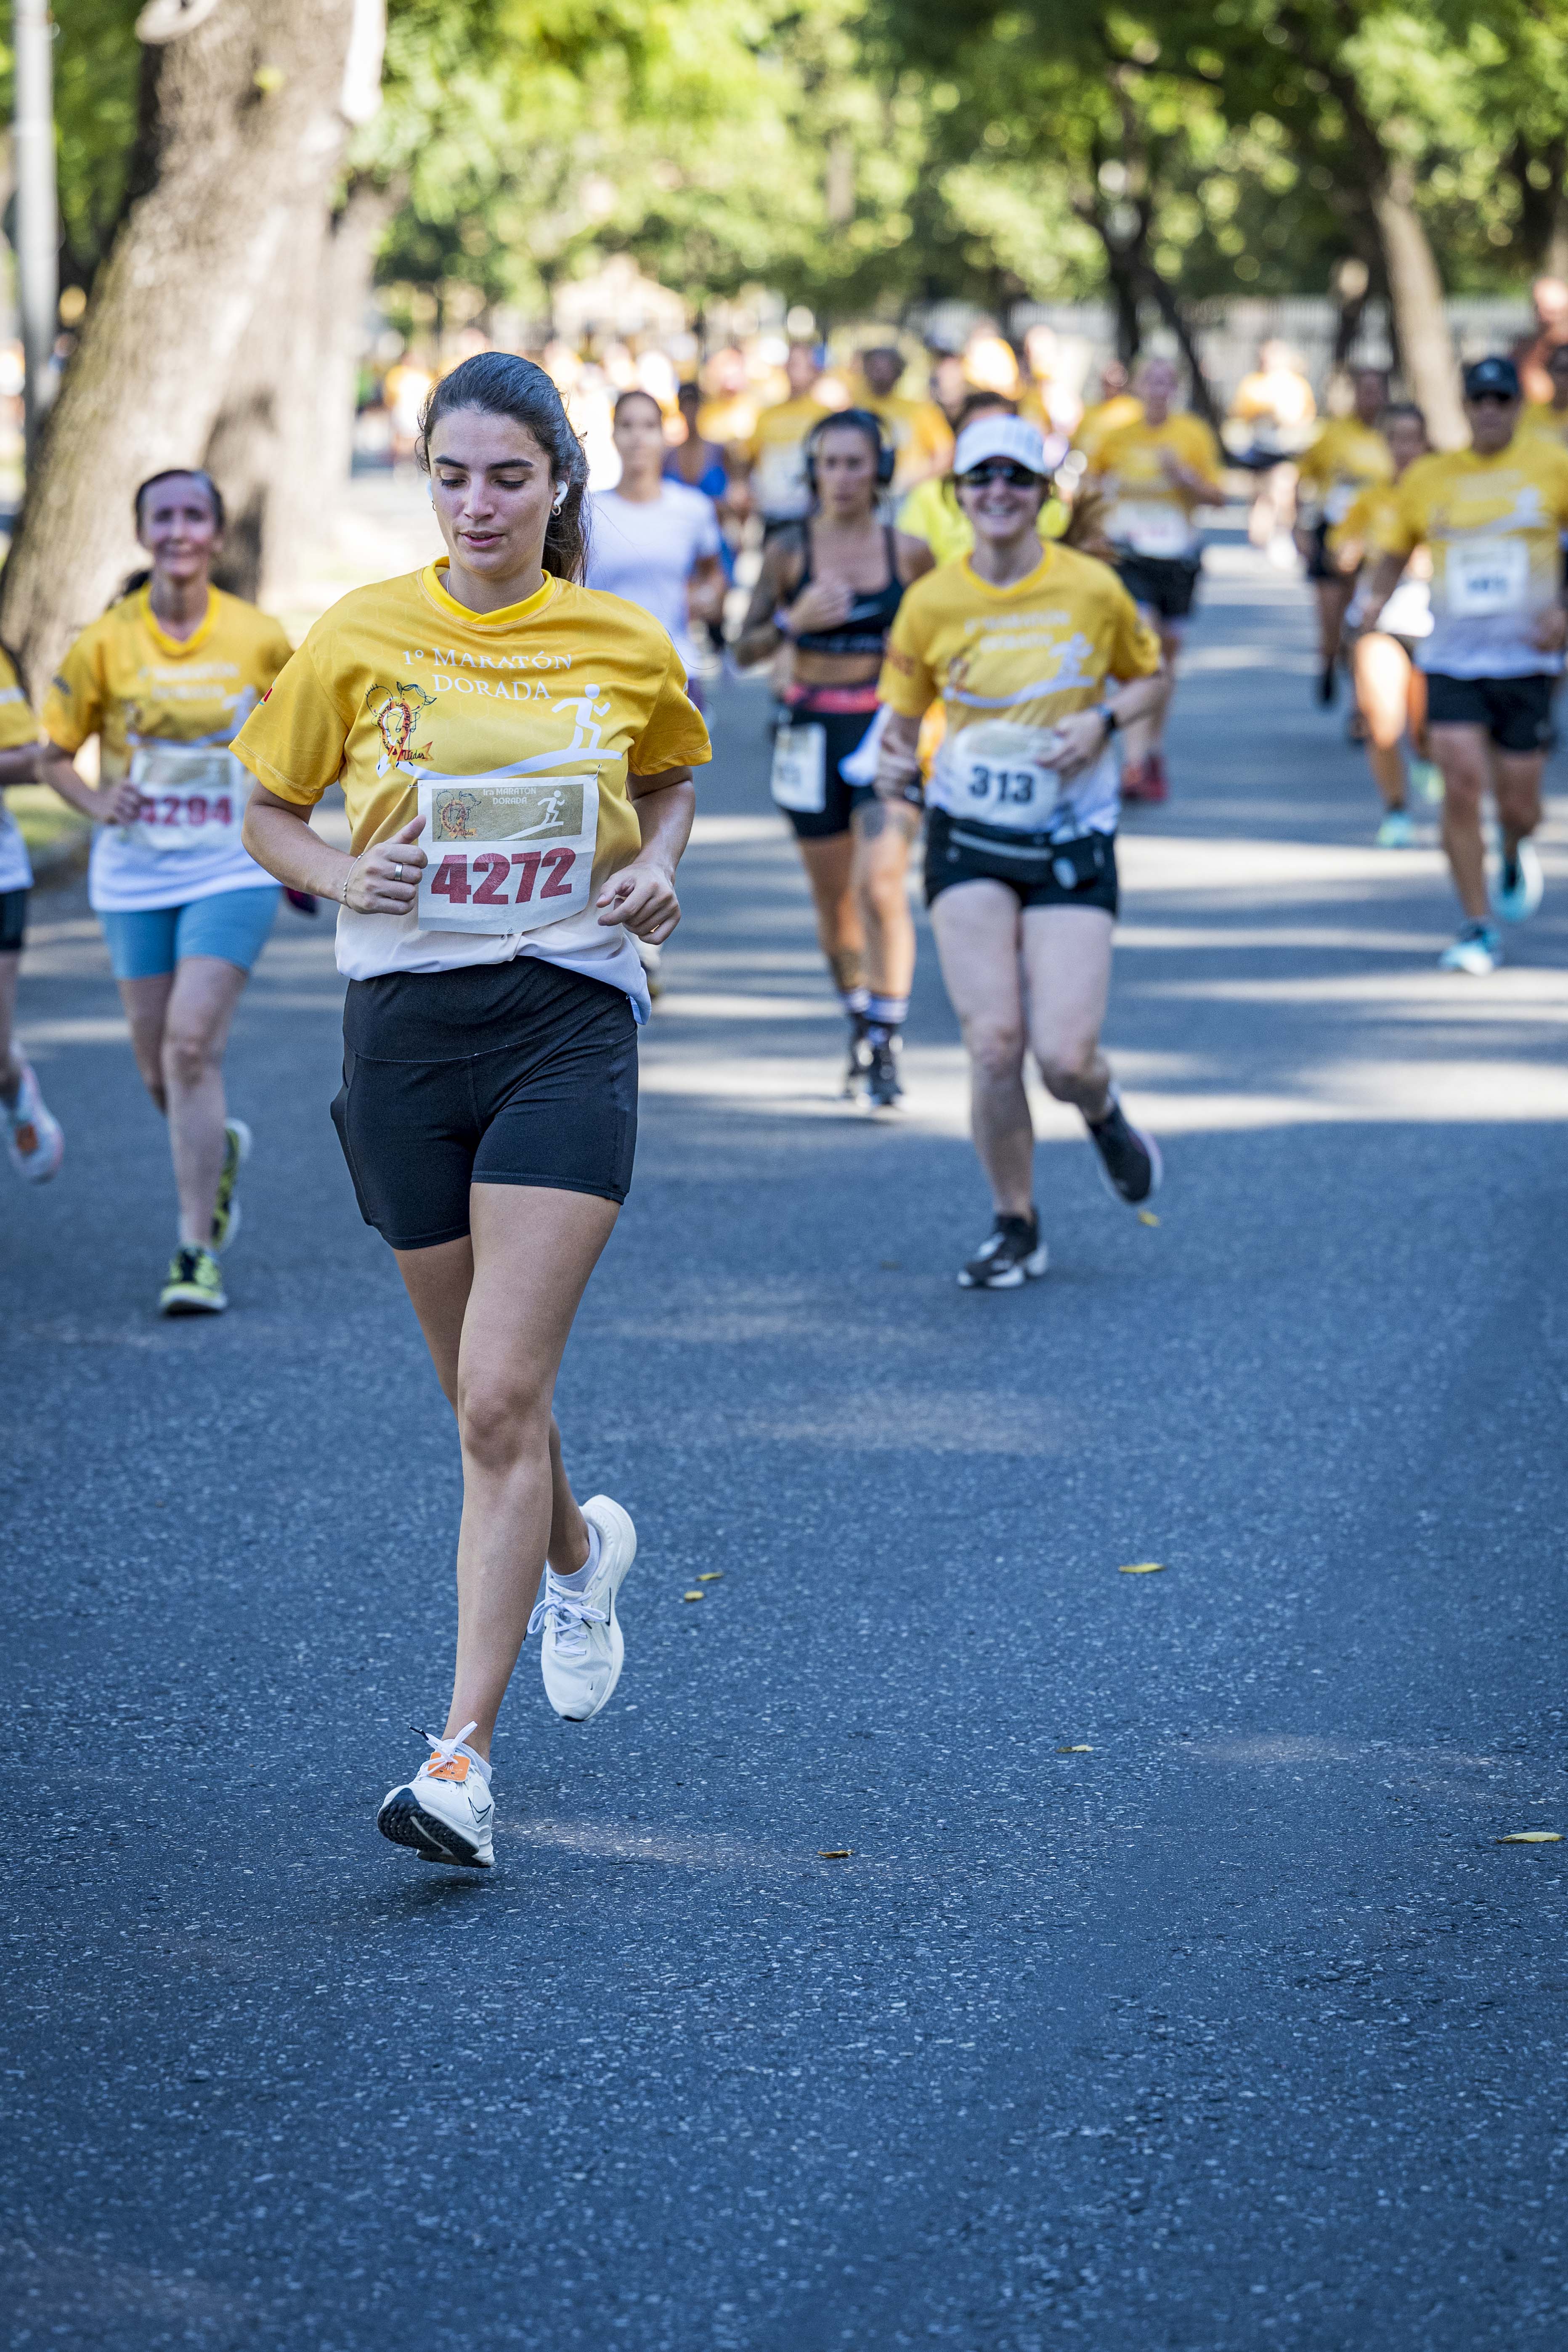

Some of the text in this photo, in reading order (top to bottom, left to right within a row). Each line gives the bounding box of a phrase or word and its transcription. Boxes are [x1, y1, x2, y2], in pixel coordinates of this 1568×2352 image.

[432, 648, 572, 669] MARATÓN
[431, 674, 552, 701] DORADA
[968, 765, 1033, 804] 313
[493, 796, 528, 804] DORADA
[431, 847, 576, 905] 4272
